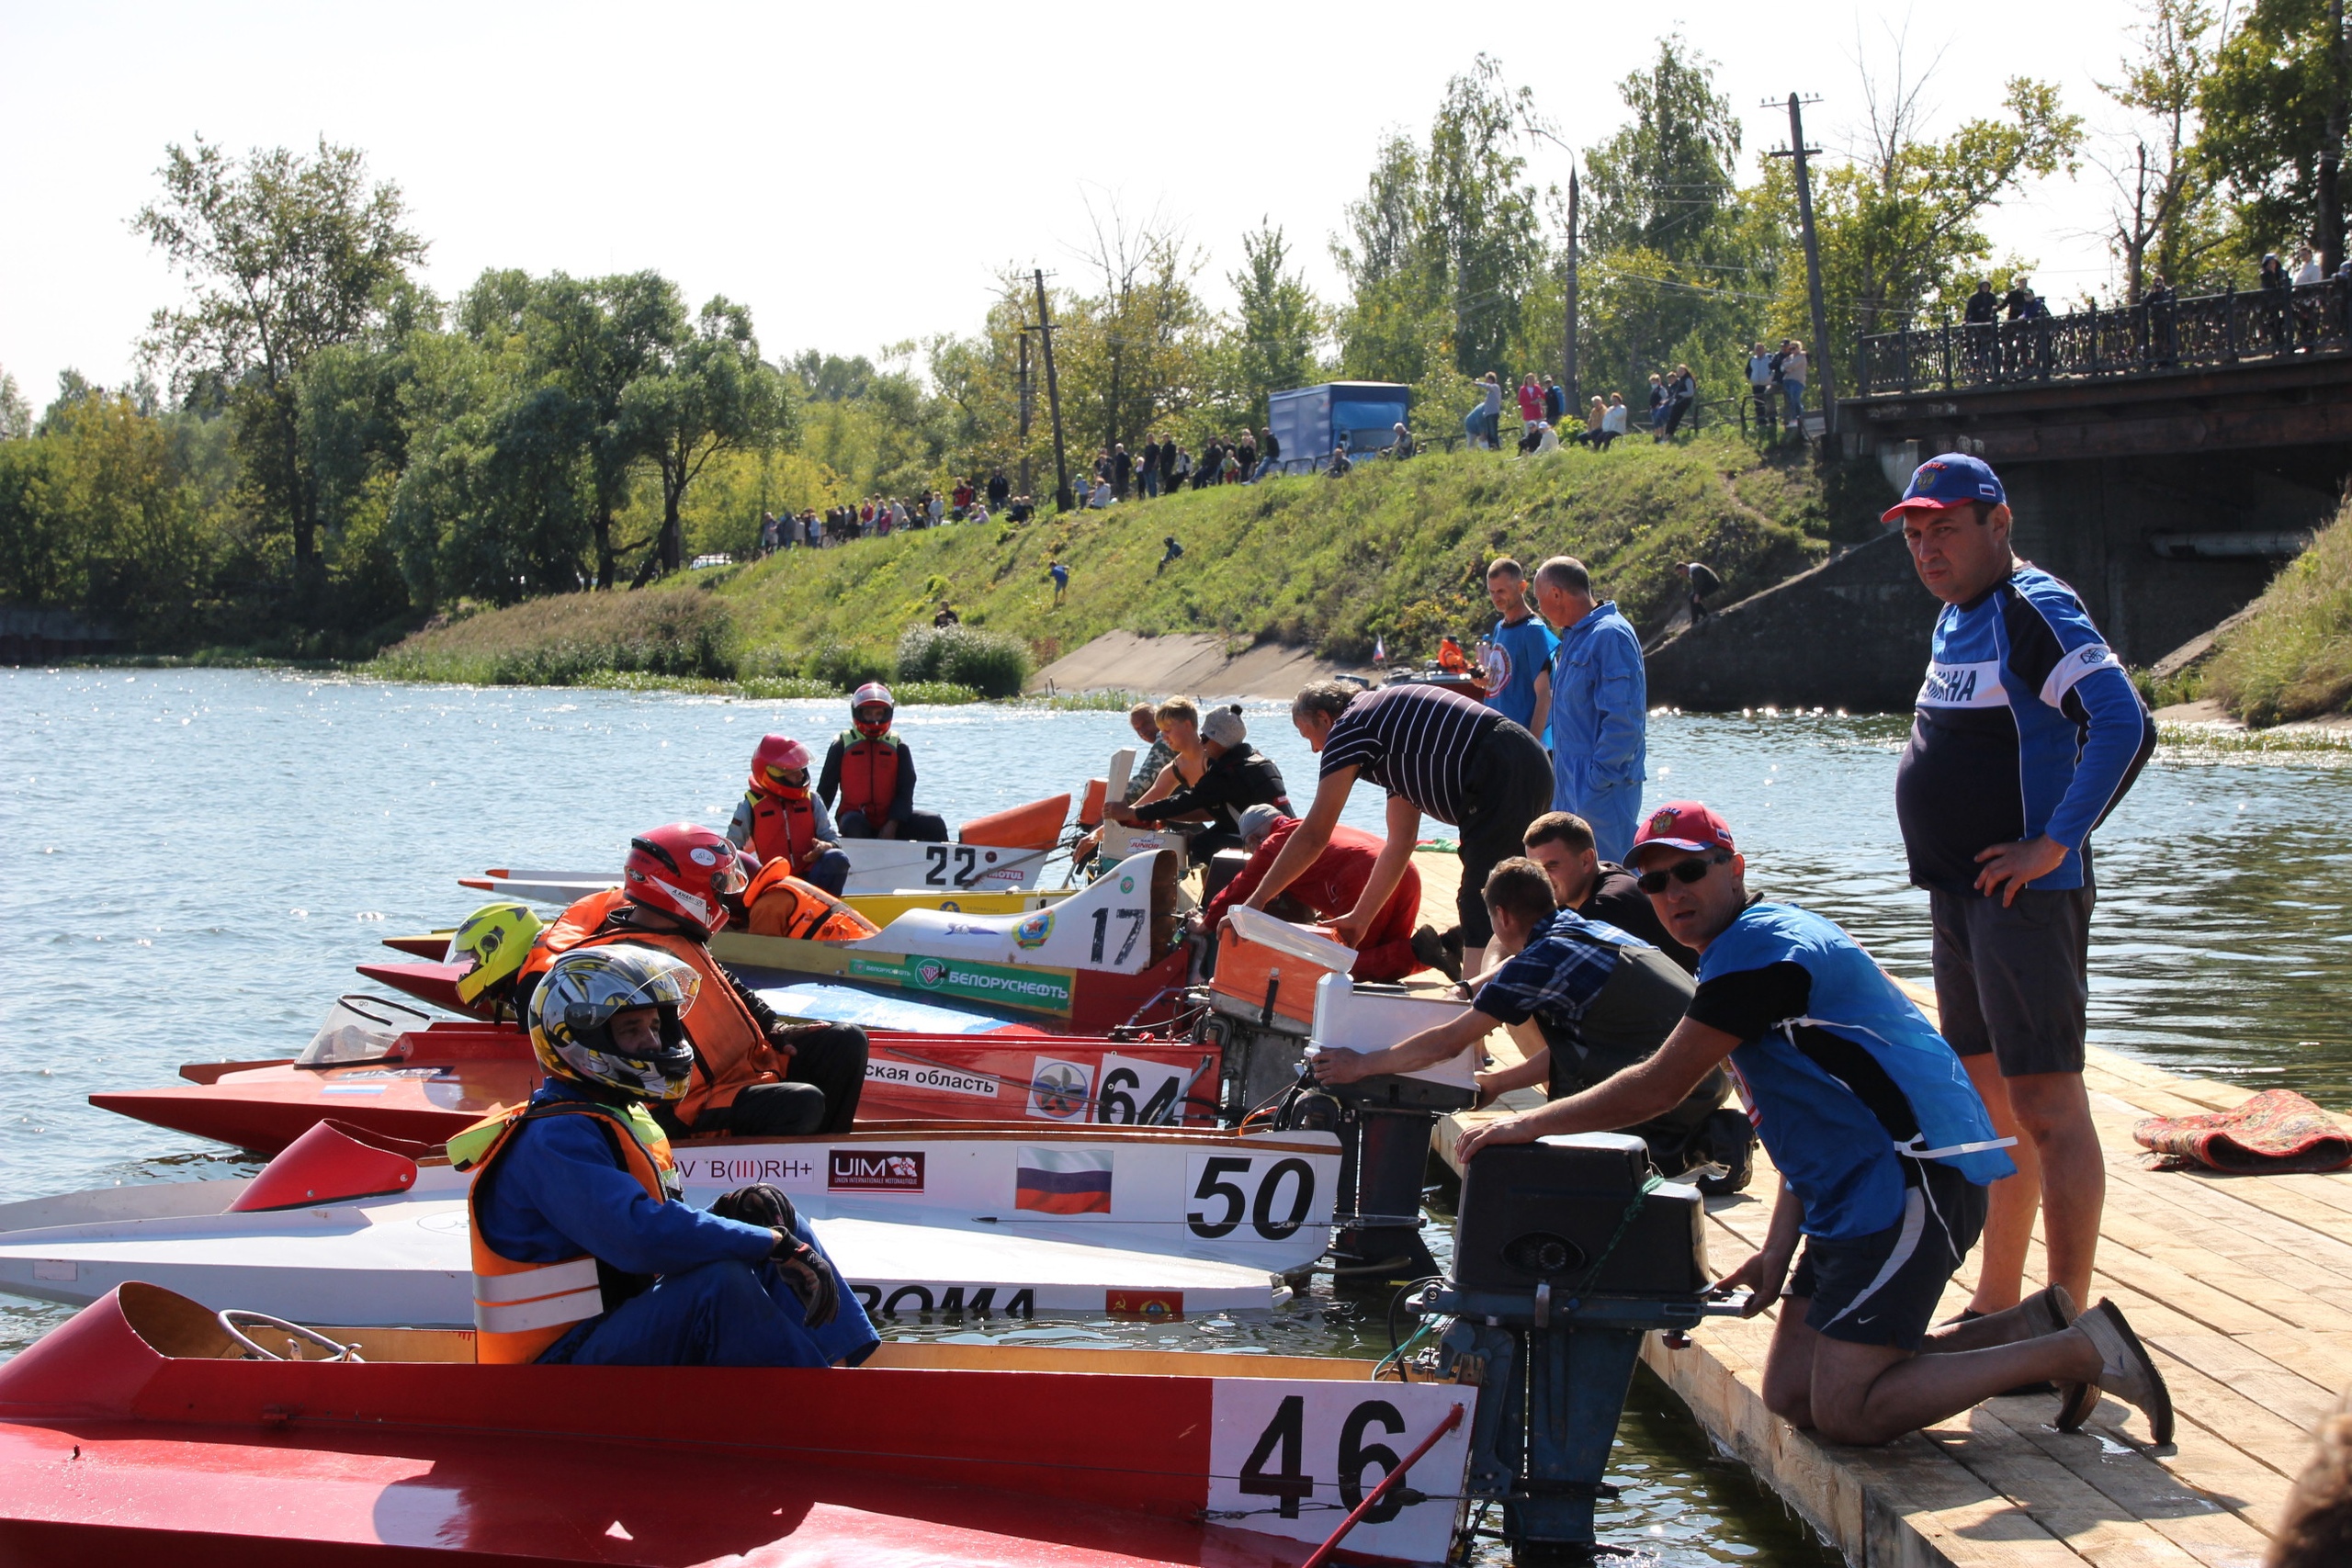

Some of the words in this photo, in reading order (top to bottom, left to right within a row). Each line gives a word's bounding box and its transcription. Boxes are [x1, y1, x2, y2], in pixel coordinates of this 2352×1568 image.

[926, 846, 976, 886] 22
[1091, 908, 1146, 965] 17
[866, 965, 911, 976] БЕЛОРУСФТЬ
[949, 971, 1069, 999] БЕЛОРУСНЕФТЬ
[915, 1069, 995, 1093] область
[1098, 1067, 1184, 1127] 64
[835, 1157, 886, 1177] UIM
[1187, 1156, 1315, 1240] 50
[1239, 1395, 1406, 1524] 46
